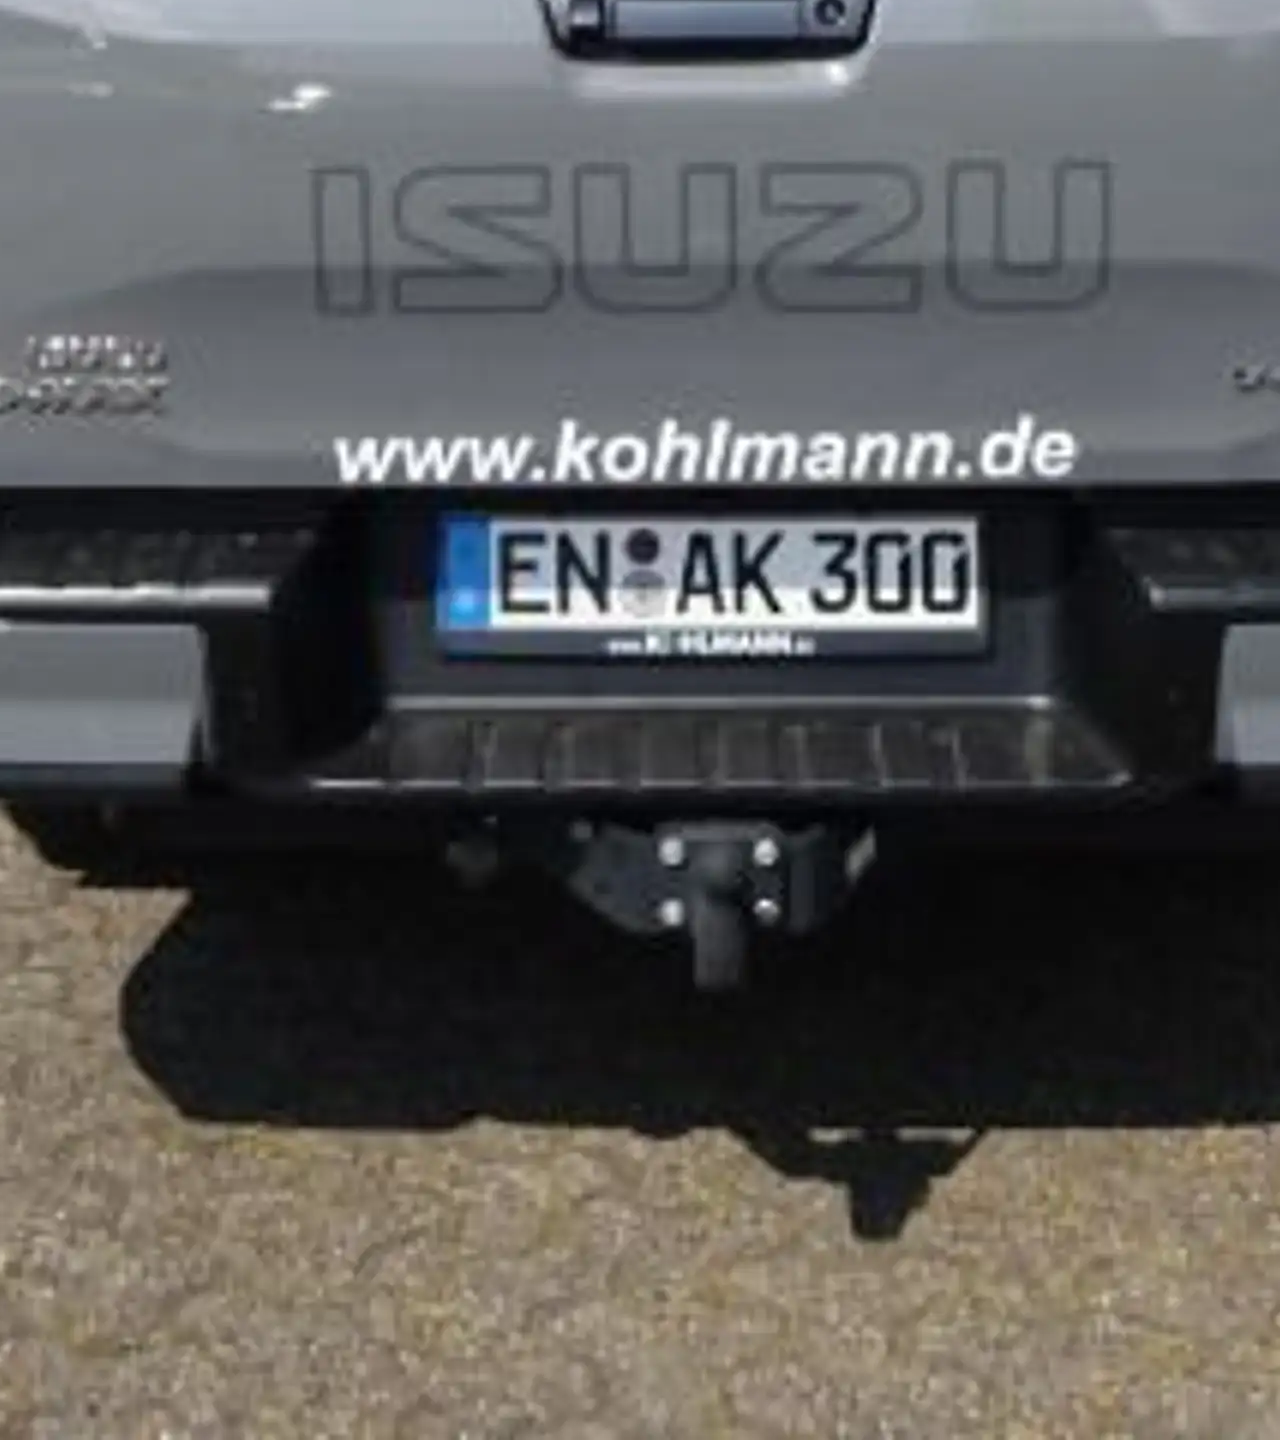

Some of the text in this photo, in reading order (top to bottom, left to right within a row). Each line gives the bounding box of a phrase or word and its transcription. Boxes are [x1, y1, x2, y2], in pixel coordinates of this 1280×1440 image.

[311, 162, 1111, 316] ISUZU
[333, 415, 1080, 483] www.kohlmann.de
[496, 531, 971, 614] EN AK 300
